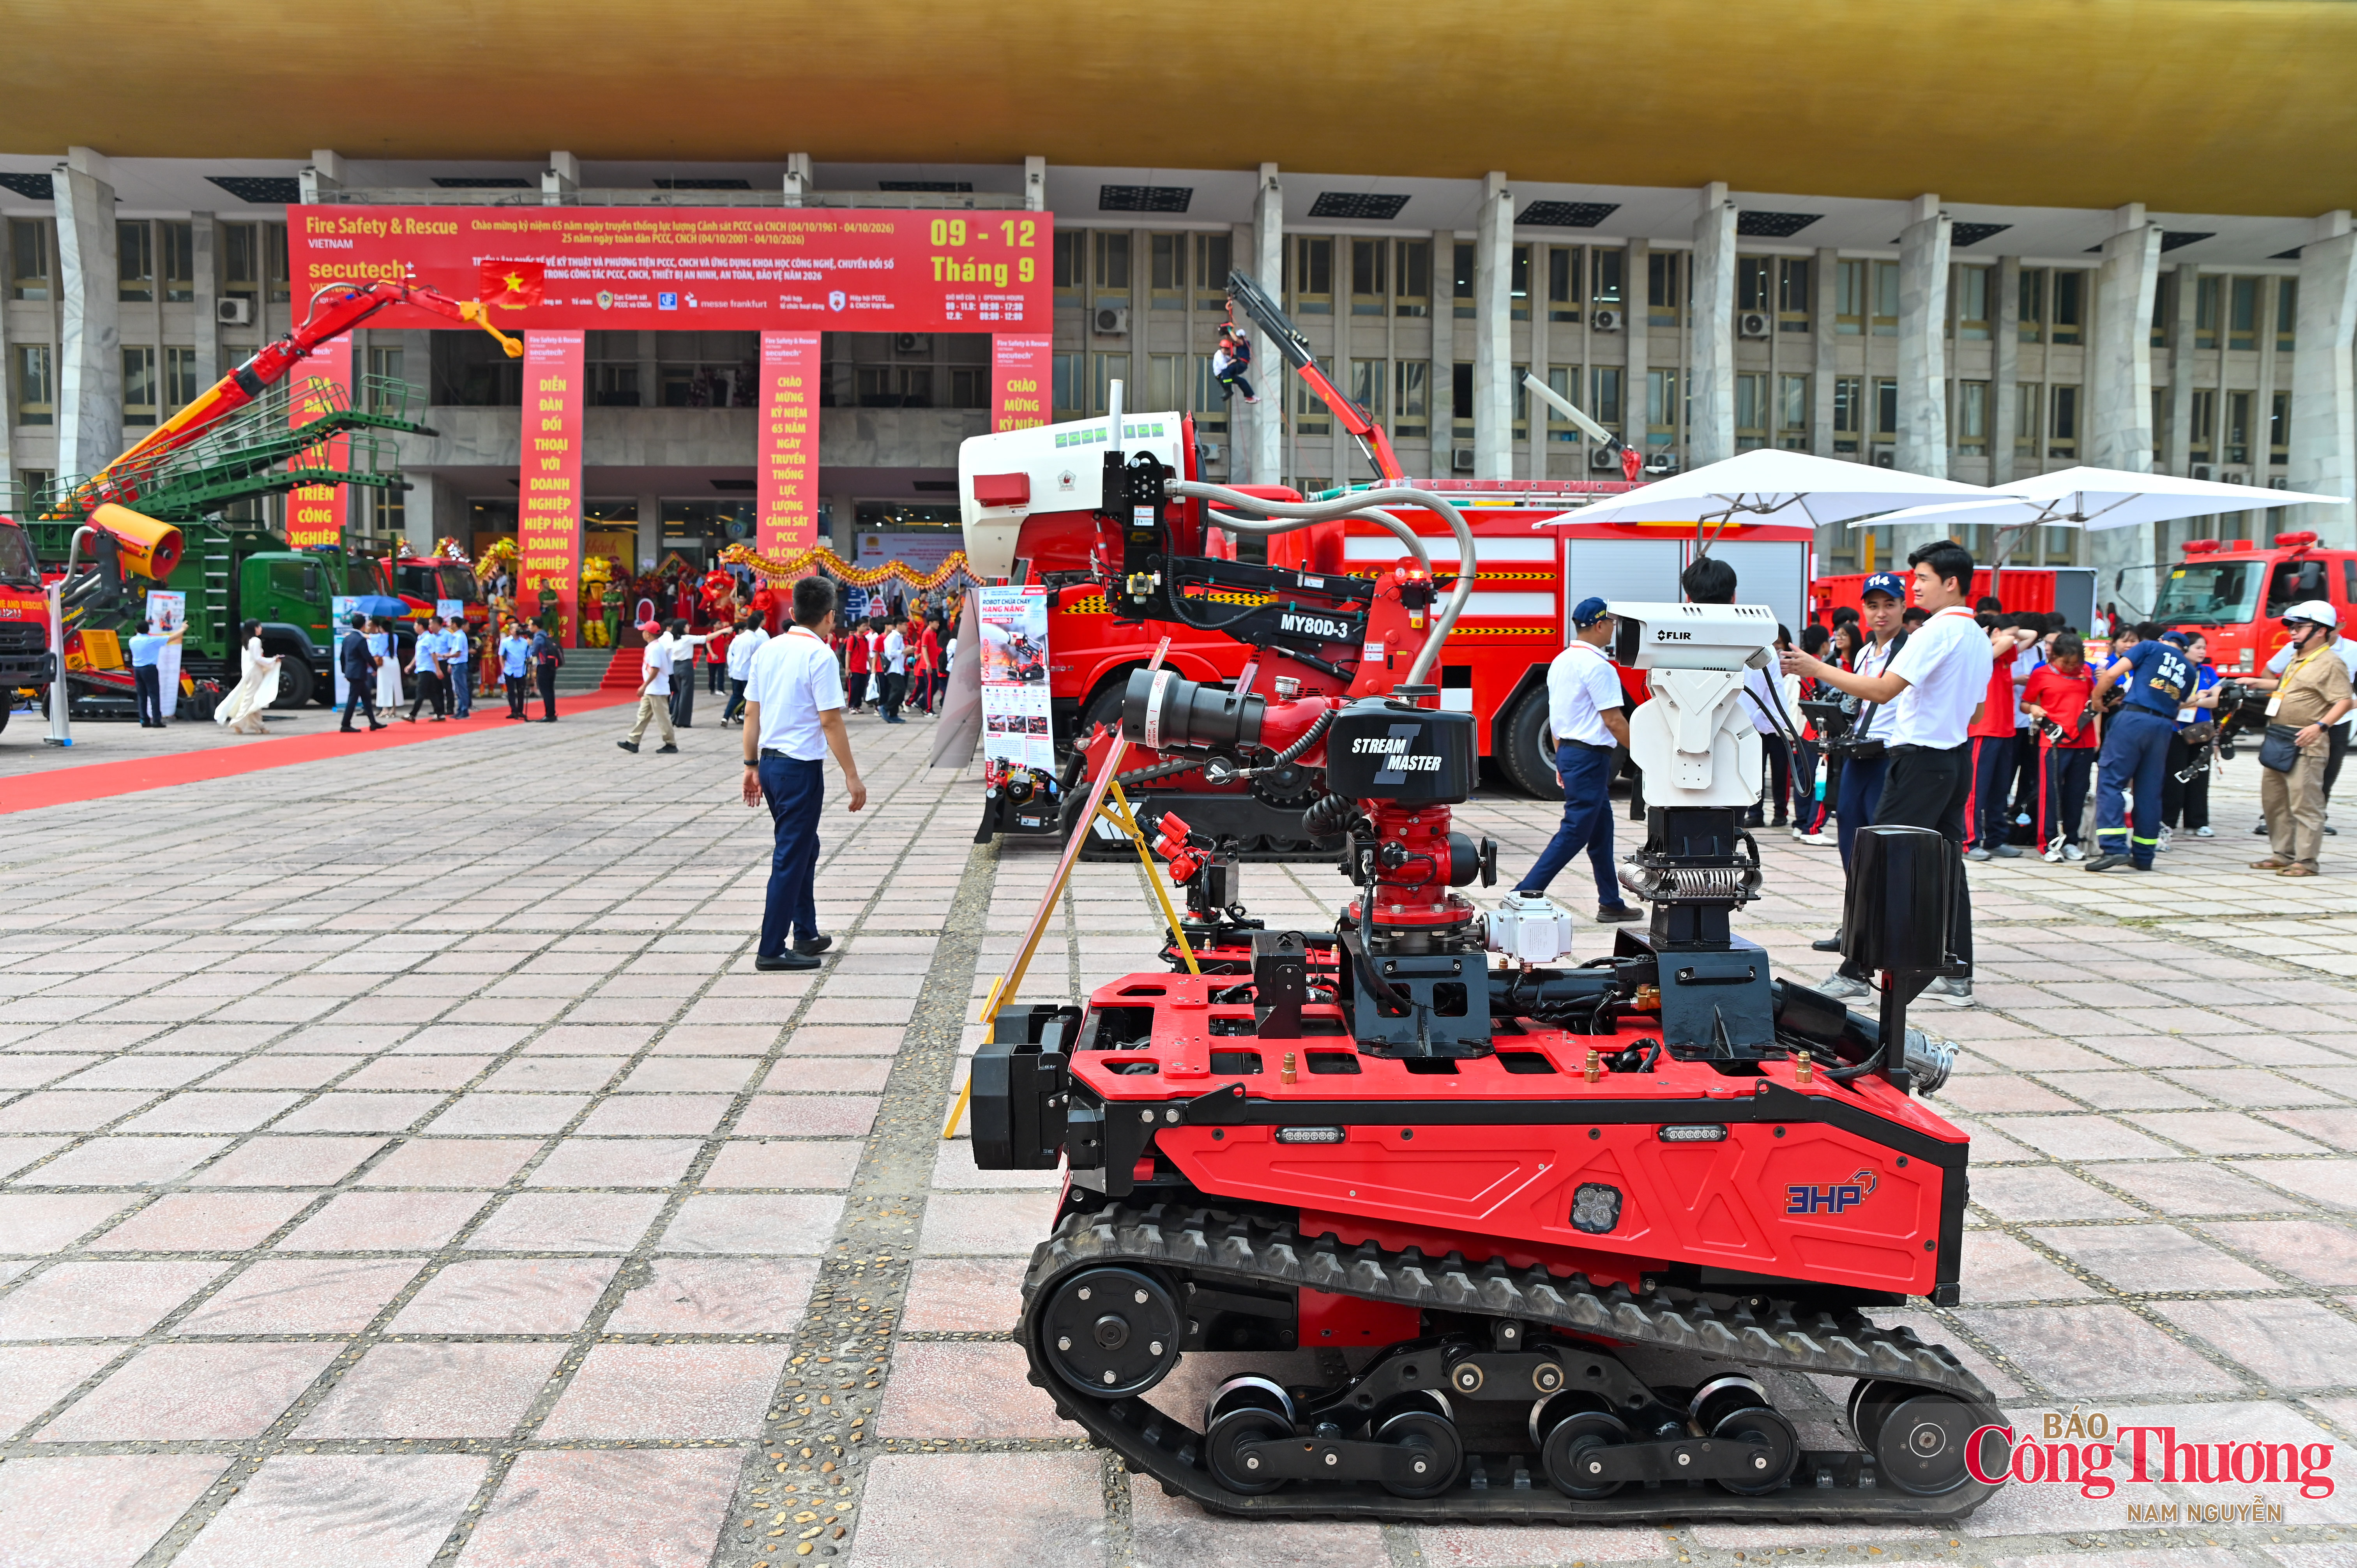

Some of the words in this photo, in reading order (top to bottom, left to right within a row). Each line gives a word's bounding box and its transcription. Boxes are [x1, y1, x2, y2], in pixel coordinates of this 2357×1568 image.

[306, 217, 336, 234] Fire
[339, 217, 388, 238] Safety
[390, 217, 403, 234] &
[406, 217, 459, 235] Rescue
[472, 220, 492, 230] Chào
[530, 220, 551, 232] niệm
[552, 221, 562, 231] 65
[564, 221, 583, 231] năm
[583, 220, 604, 233] ngày
[719, 221, 732, 231] sát
[733, 221, 753, 231] PCCC
[765, 221, 787, 232] CNCH
[931, 219, 966, 247] 09
[1000, 219, 1035, 247] 12
[307, 238, 353, 249] VIETNAM
[562, 233, 572, 243] 25
[573, 233, 592, 243] năm
[593, 233, 613, 245] ngày
[675, 233, 697, 244] CNCH
[678, 258, 699, 268] CNCH
[752, 258, 774, 268] KHOA
[544, 269, 569, 279] TRONG
[684, 270, 696, 280] AN
[720, 270, 732, 280] AN
[802, 271, 822, 281] 2026
[931, 256, 1008, 288] Tháng
[1019, 257, 1035, 282] 9
[730, 299, 767, 309] frankfurt
[540, 375, 567, 392] DIỄN
[777, 375, 802, 387] CHÀO
[1007, 378, 1037, 392] CHÀO
[539, 396, 564, 411] ĐÀN
[775, 390, 804, 403] MỪNG
[1004, 397, 1040, 412] MỪNG
[771, 405, 783, 418] KỶ
[784, 406, 808, 421] NIỆM
[541, 415, 562, 431] ĐỐI
[771, 423, 783, 433] 65
[785, 421, 806, 433] NĂM
[999, 415, 1014, 431] KỶ
[1055, 426, 1164, 444] ZOOMION
[534, 438, 569, 454] THOẠI
[777, 437, 801, 449] NGÀY
[540, 456, 561, 471] VỚI
[770, 451, 806, 464] TRUYỀN
[772, 467, 804, 480] THỐNG
[530, 478, 570, 491] DOANH
[779, 484, 797, 498] LỰC
[528, 496, 571, 514] NGHIỆP
[772, 500, 803, 514] LƯỢNG
[297, 506, 332, 523] CÔNG
[765, 513, 791, 526] CẢNH
[792, 514, 809, 526] SÁT
[524, 515, 552, 533] HIỆP
[552, 515, 574, 533] HỘI
[528, 537, 569, 550] DOANH
[776, 531, 798, 542] PCCC
[767, 546, 780, 558] VÀ
[526, 555, 570, 573] NGHIỆP
[525, 573, 541, 590] VỀ
[1868, 574, 1890, 587] 114
[7, 600, 20, 609] AND
[21, 600, 43, 611] RESCUE
[1280, 613, 1348, 639] MY80D-3
[1666, 631, 1691, 640] FLIR
[2163, 652, 2186, 676] 114
[1352, 738, 1407, 754] STREAM
[1386, 755, 1442, 772] MASTER
[1786, 1185, 1862, 1215] 3HP
